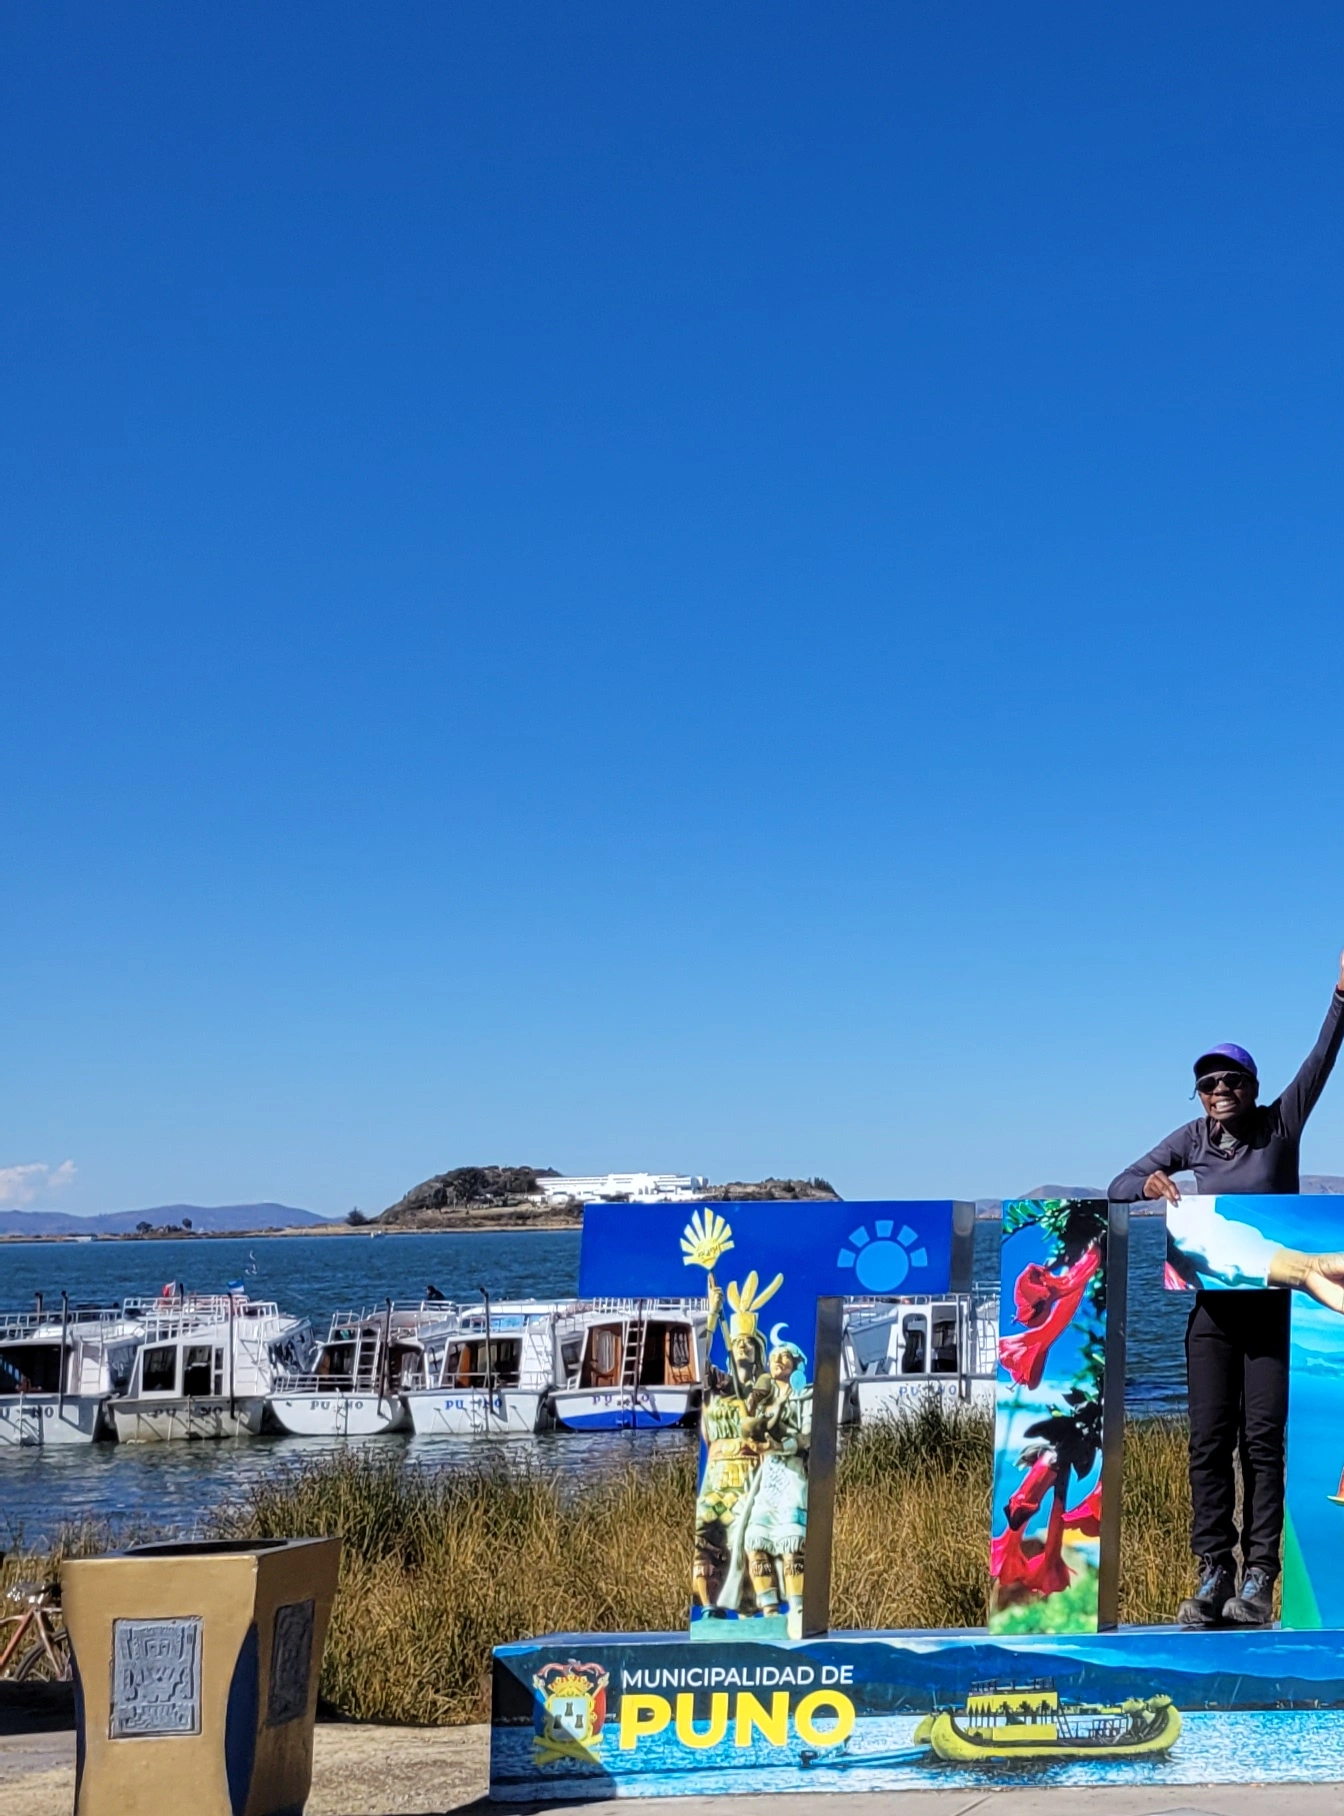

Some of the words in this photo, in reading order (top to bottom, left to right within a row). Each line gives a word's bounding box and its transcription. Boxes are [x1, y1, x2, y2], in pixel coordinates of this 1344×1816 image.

[621, 1666, 815, 1689] MUNICIPALIDAD
[820, 1665, 855, 1685] DE
[618, 1688, 857, 1751] PUNO
